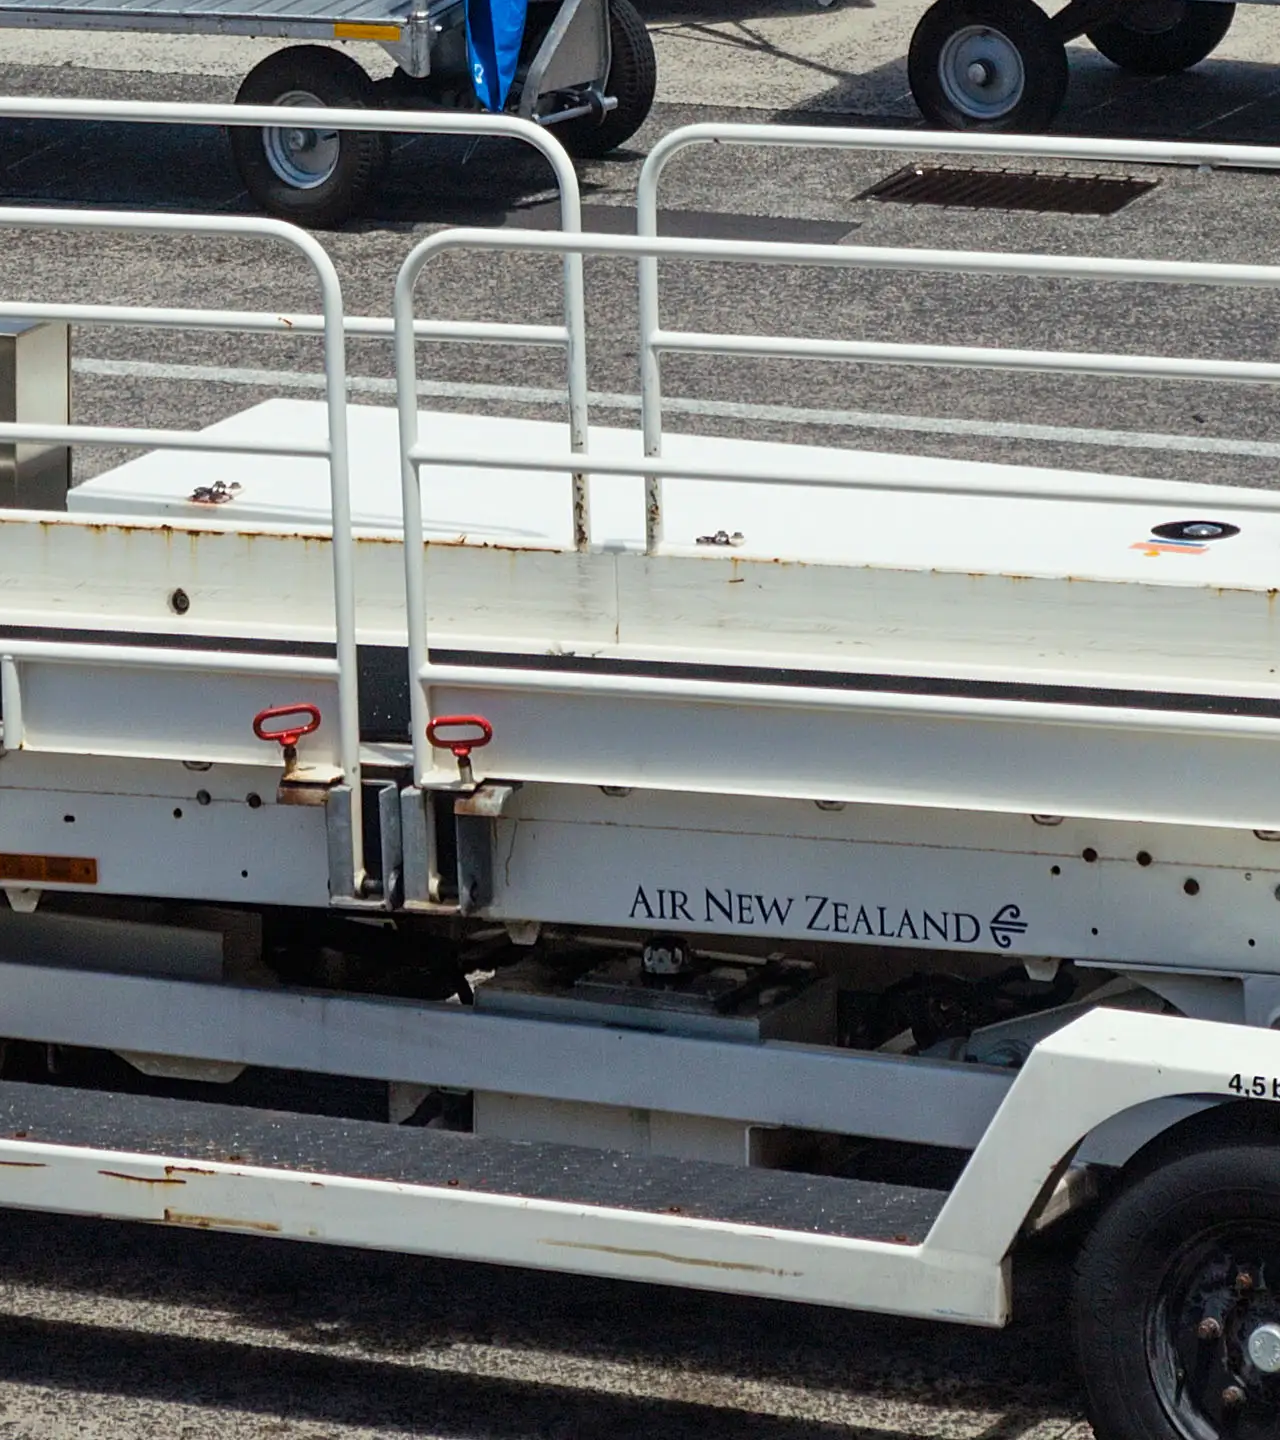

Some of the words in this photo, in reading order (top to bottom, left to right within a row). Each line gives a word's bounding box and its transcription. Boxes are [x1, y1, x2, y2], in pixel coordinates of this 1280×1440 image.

[628, 884, 696, 922] AIR
[703, 887, 795, 927] NEW
[804, 894, 981, 944] ZEALAND
[1228, 1073, 1266, 1098] 4,5
